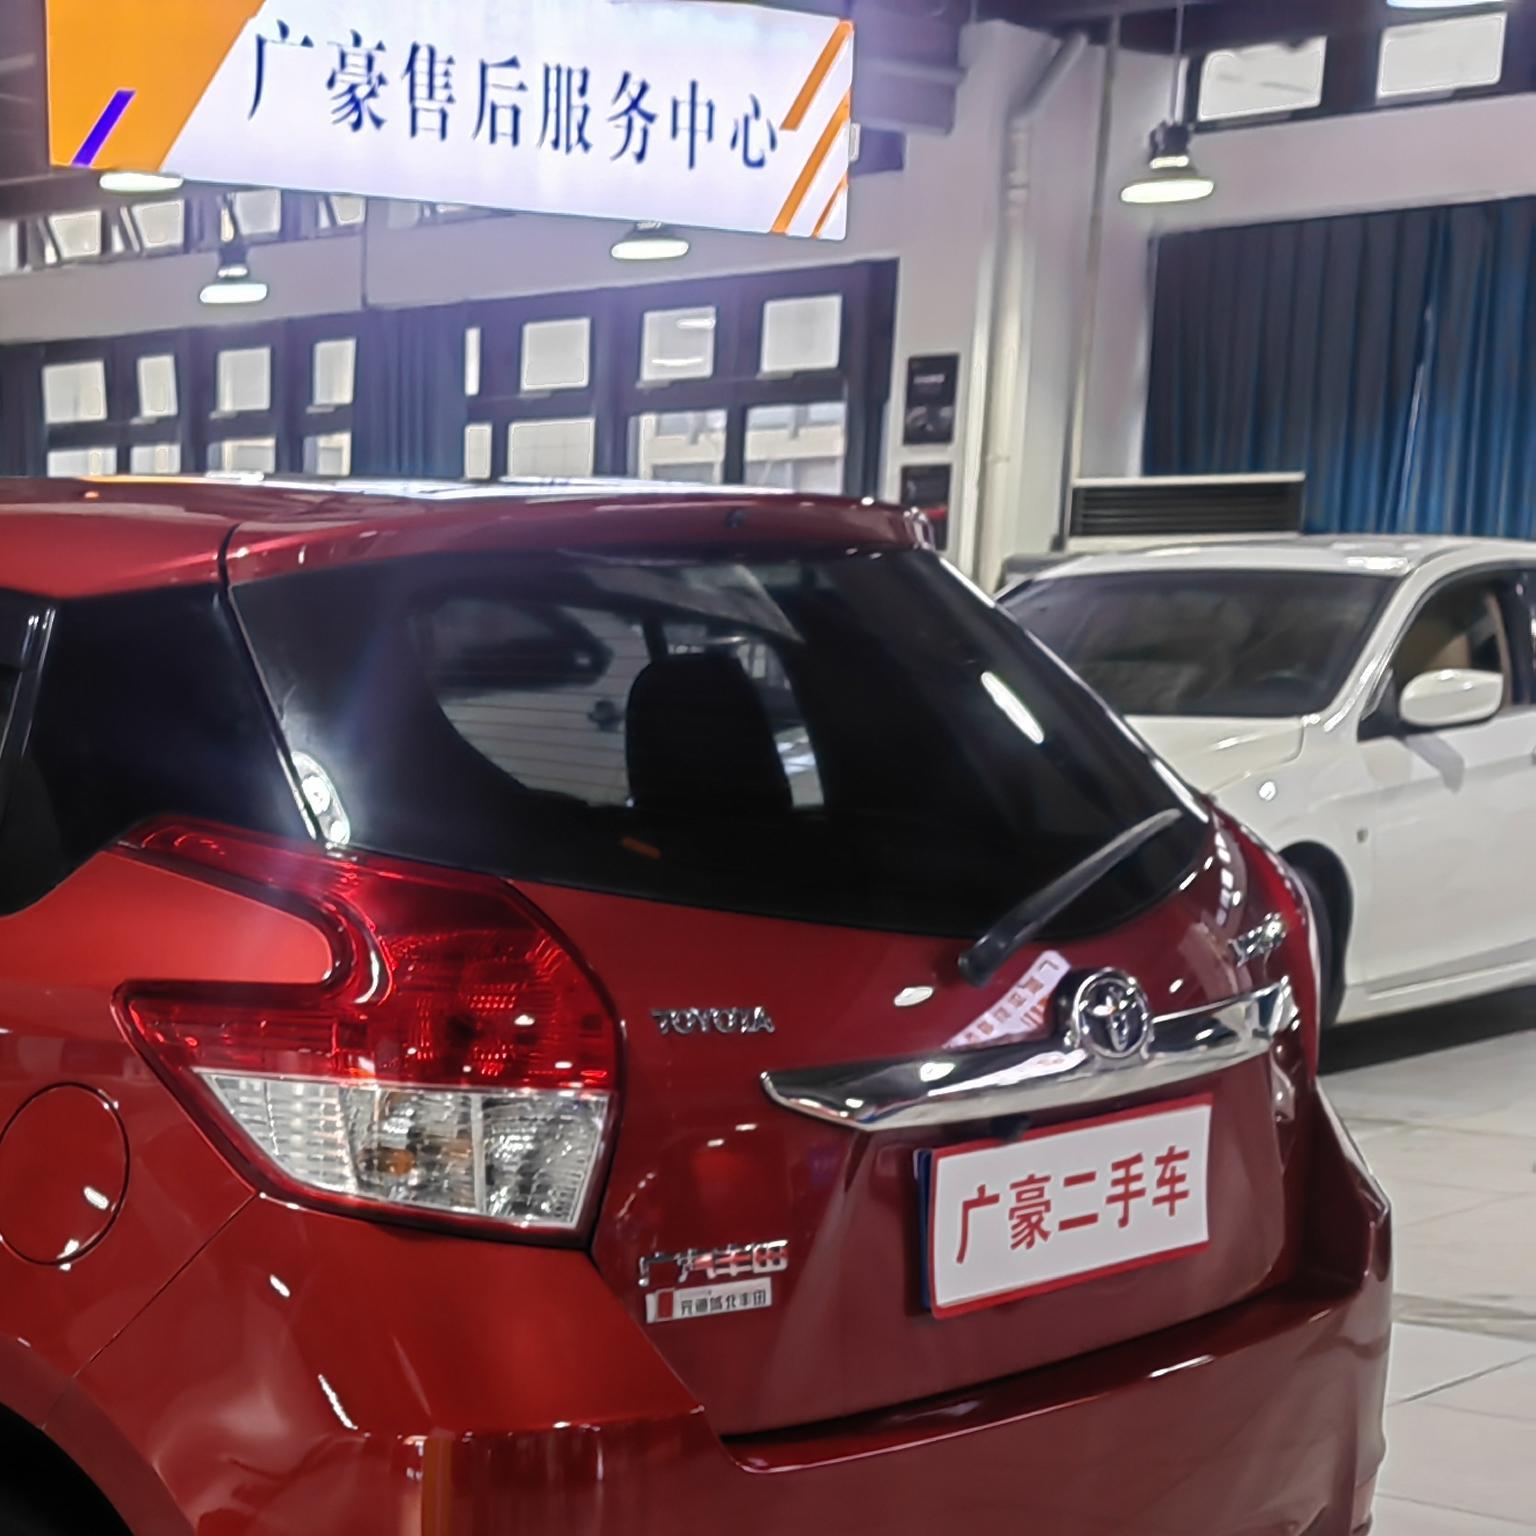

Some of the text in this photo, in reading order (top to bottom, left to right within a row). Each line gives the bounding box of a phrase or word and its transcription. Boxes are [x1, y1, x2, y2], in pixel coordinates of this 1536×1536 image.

[248, 19, 778, 170] 广豪售后服务中心
[650, 1006, 776, 1034] TOYOTA
[957, 1145, 1191, 1265] 广豪二手车
